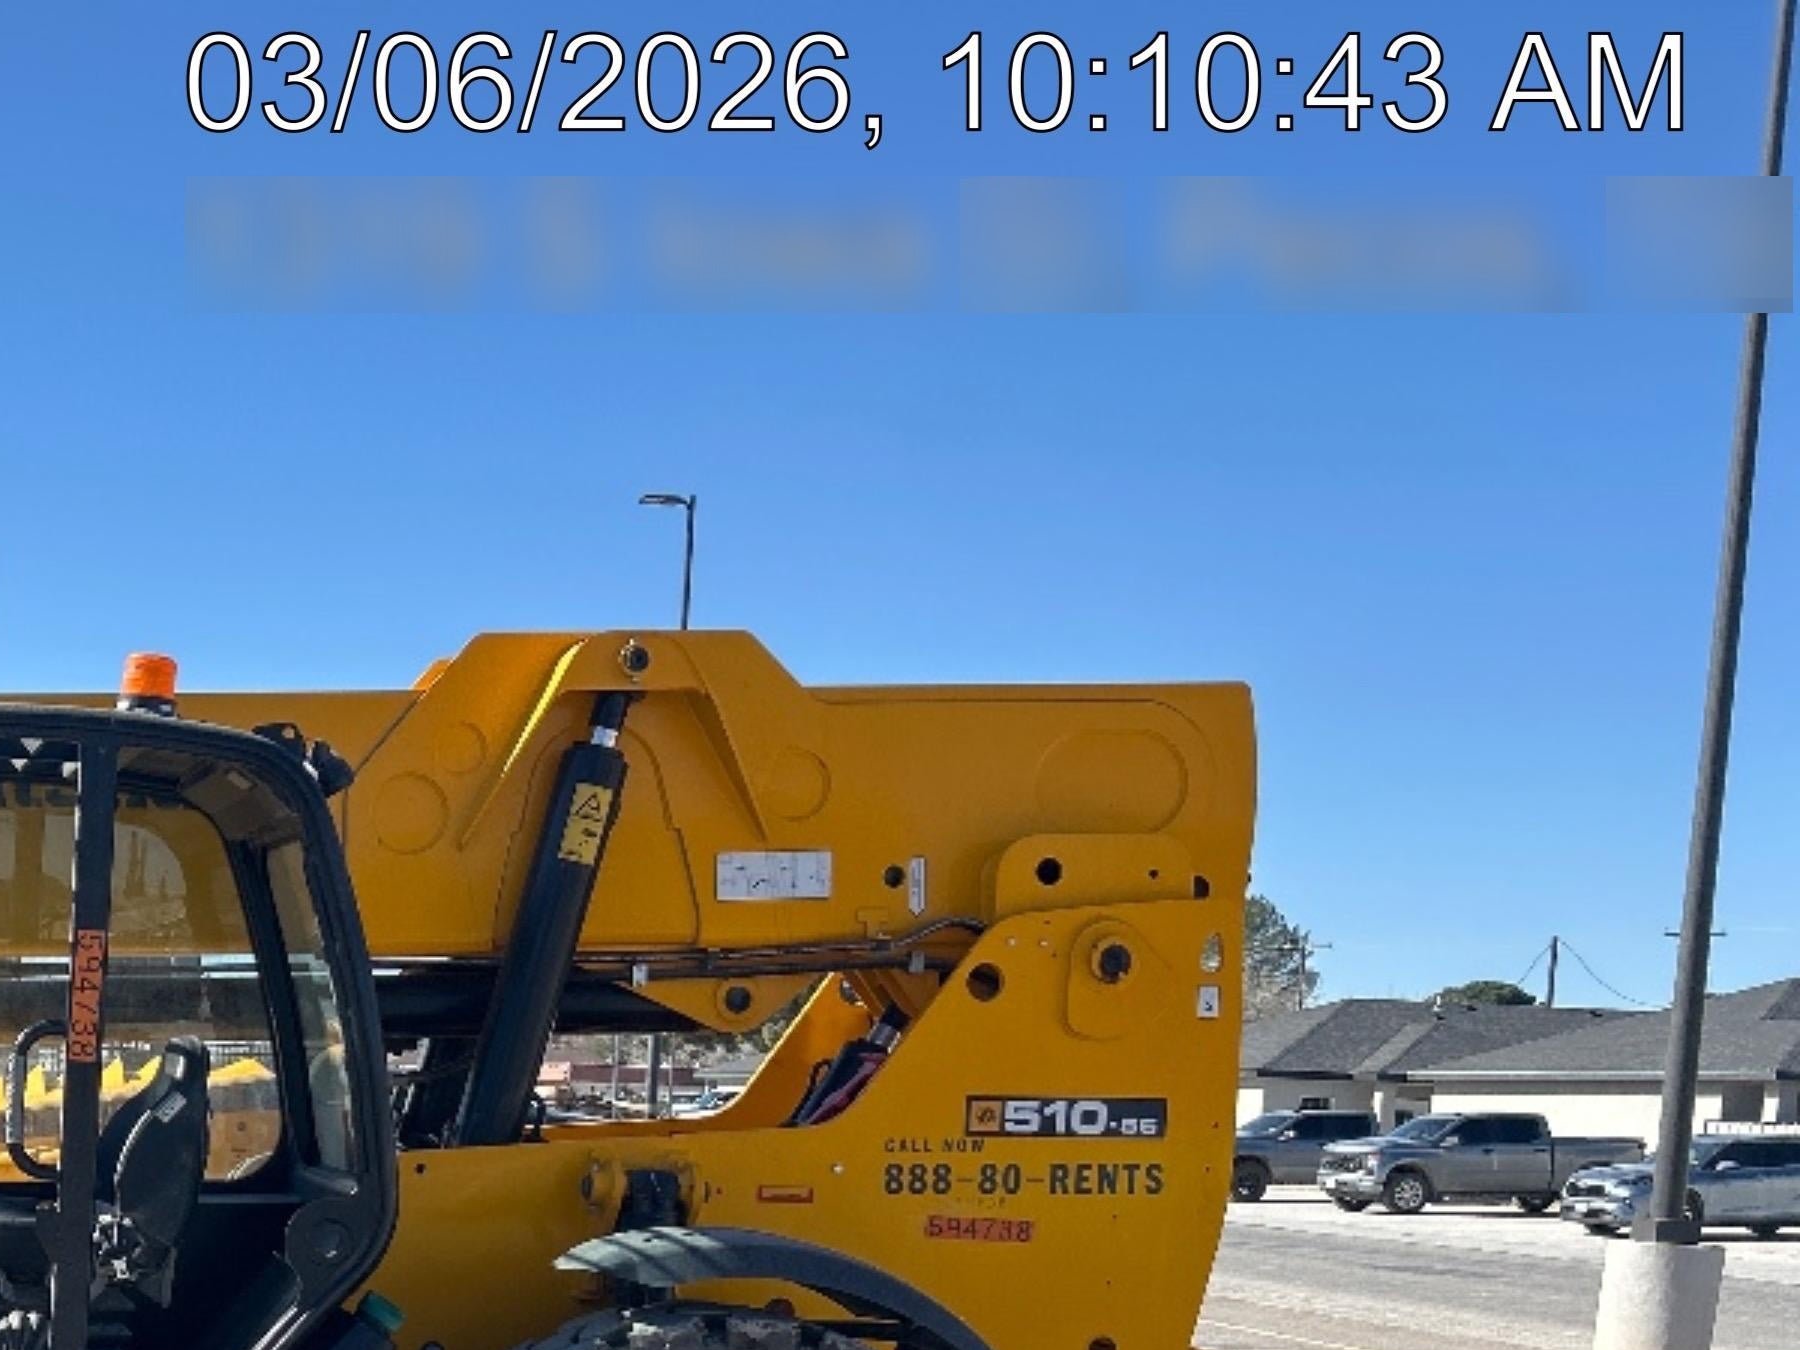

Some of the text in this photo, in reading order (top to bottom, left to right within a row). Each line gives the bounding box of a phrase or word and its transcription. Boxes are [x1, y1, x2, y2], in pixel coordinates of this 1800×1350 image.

[884, 1138, 985, 1153] CALL NOW
[884, 1162, 1165, 1195] 888-80-RENTS
